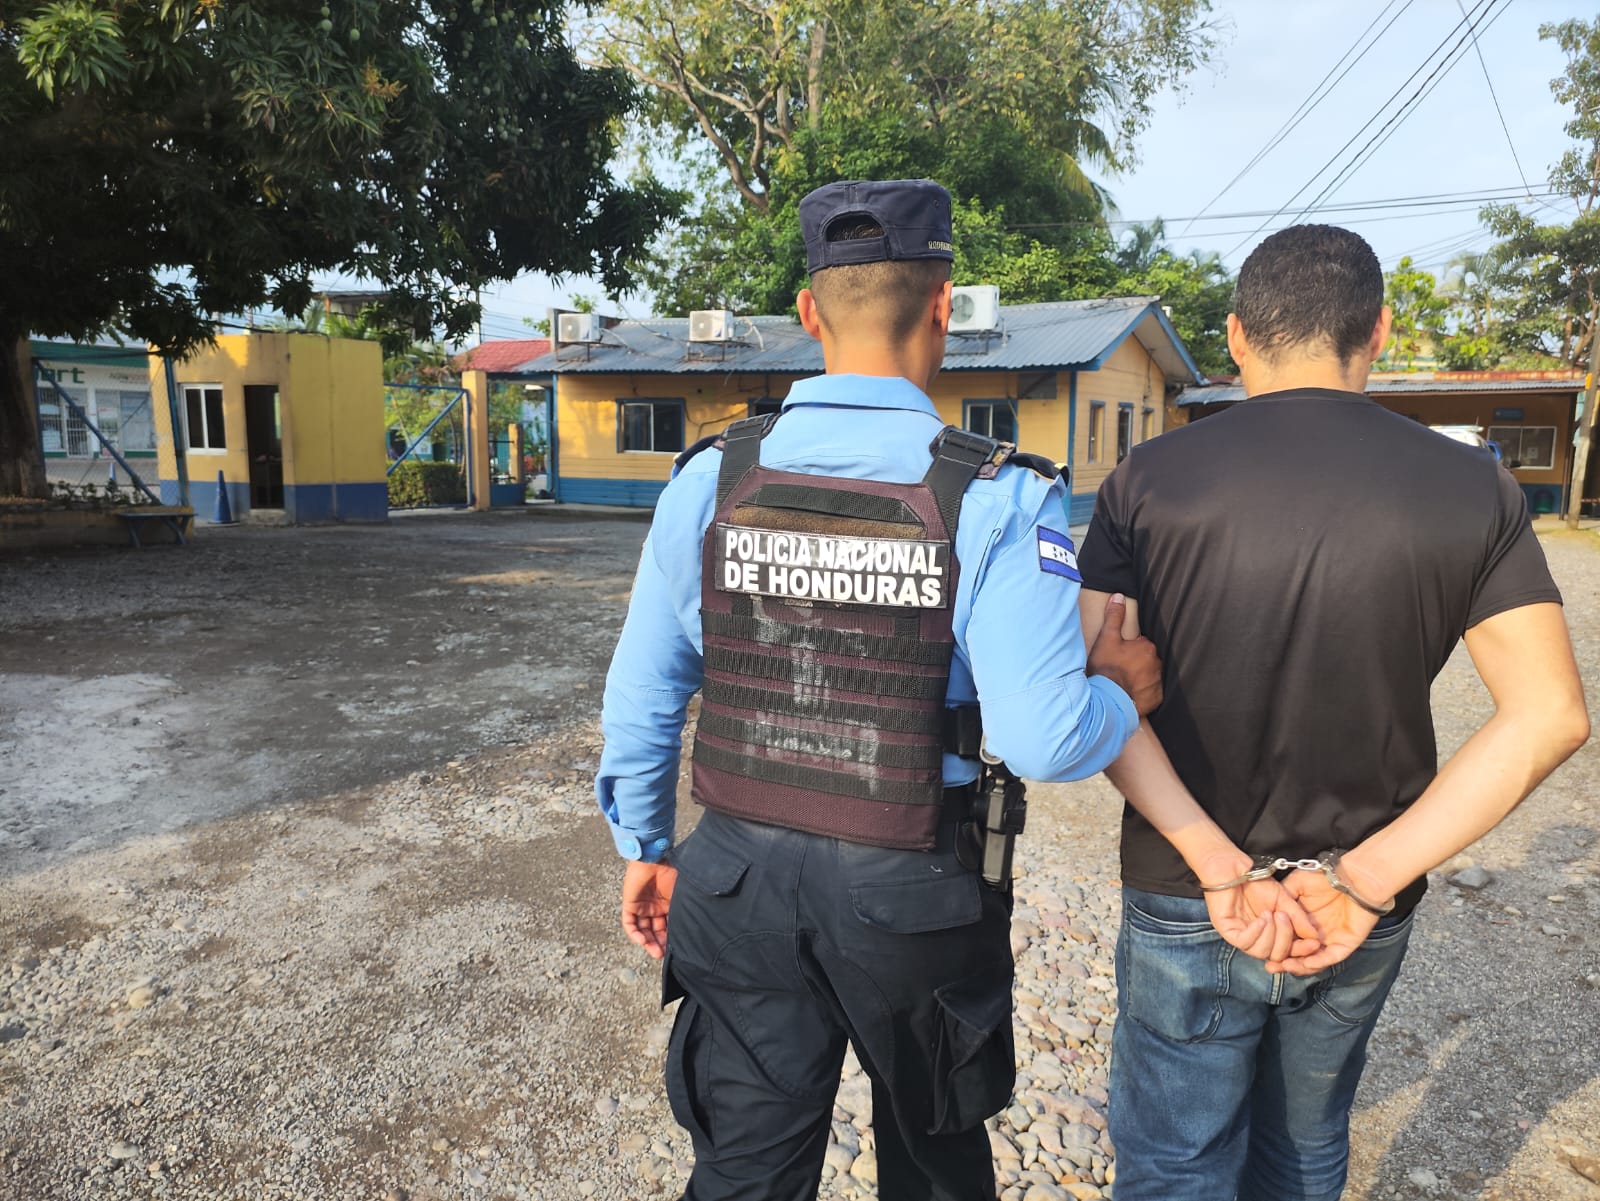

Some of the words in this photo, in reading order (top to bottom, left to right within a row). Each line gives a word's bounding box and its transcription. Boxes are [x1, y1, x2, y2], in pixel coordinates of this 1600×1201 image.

[725, 530, 812, 565] POLICIA
[817, 541, 943, 576] NACIONAL
[724, 561, 759, 592] DE
[768, 567, 941, 607] HONDURAS
